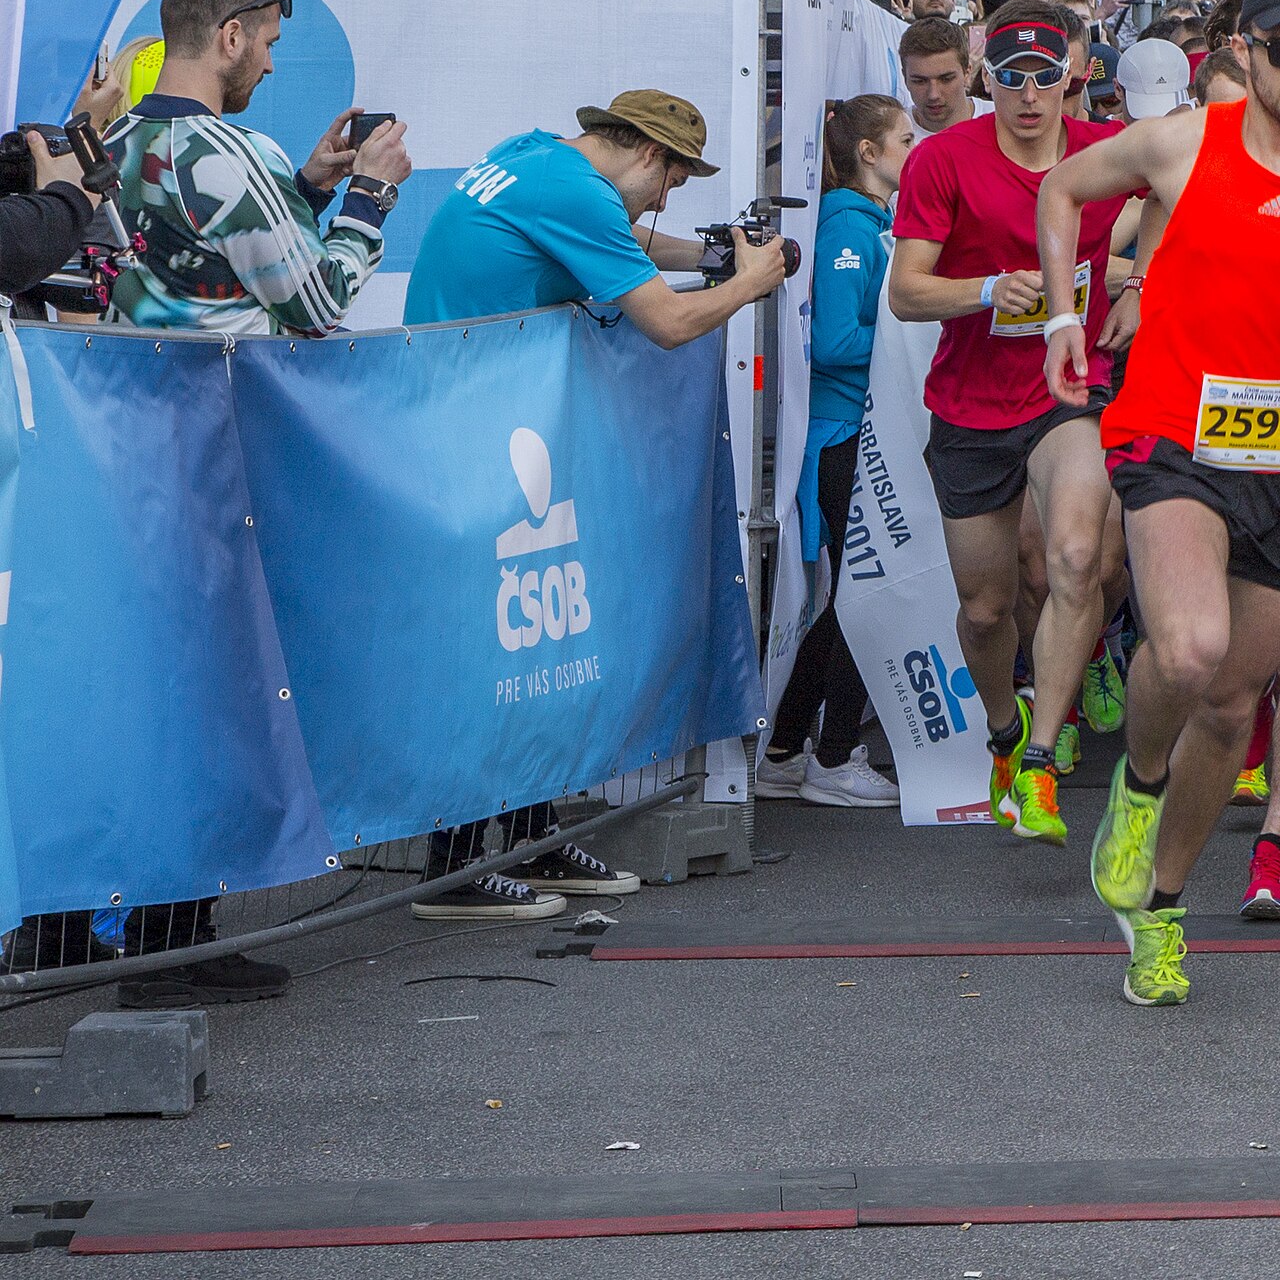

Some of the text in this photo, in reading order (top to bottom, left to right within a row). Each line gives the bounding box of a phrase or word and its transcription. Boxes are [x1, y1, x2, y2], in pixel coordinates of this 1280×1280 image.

[860, 420, 912, 549] BRATISLAVA
[844, 506, 886, 581] 2017
[496, 561, 591, 652] ČSOB
[496, 656, 601, 706] PRE VÁS OSOBNE
[884, 658, 924, 750] PRE VÁS OSOBNE
[903, 650, 950, 743] ČSOB
